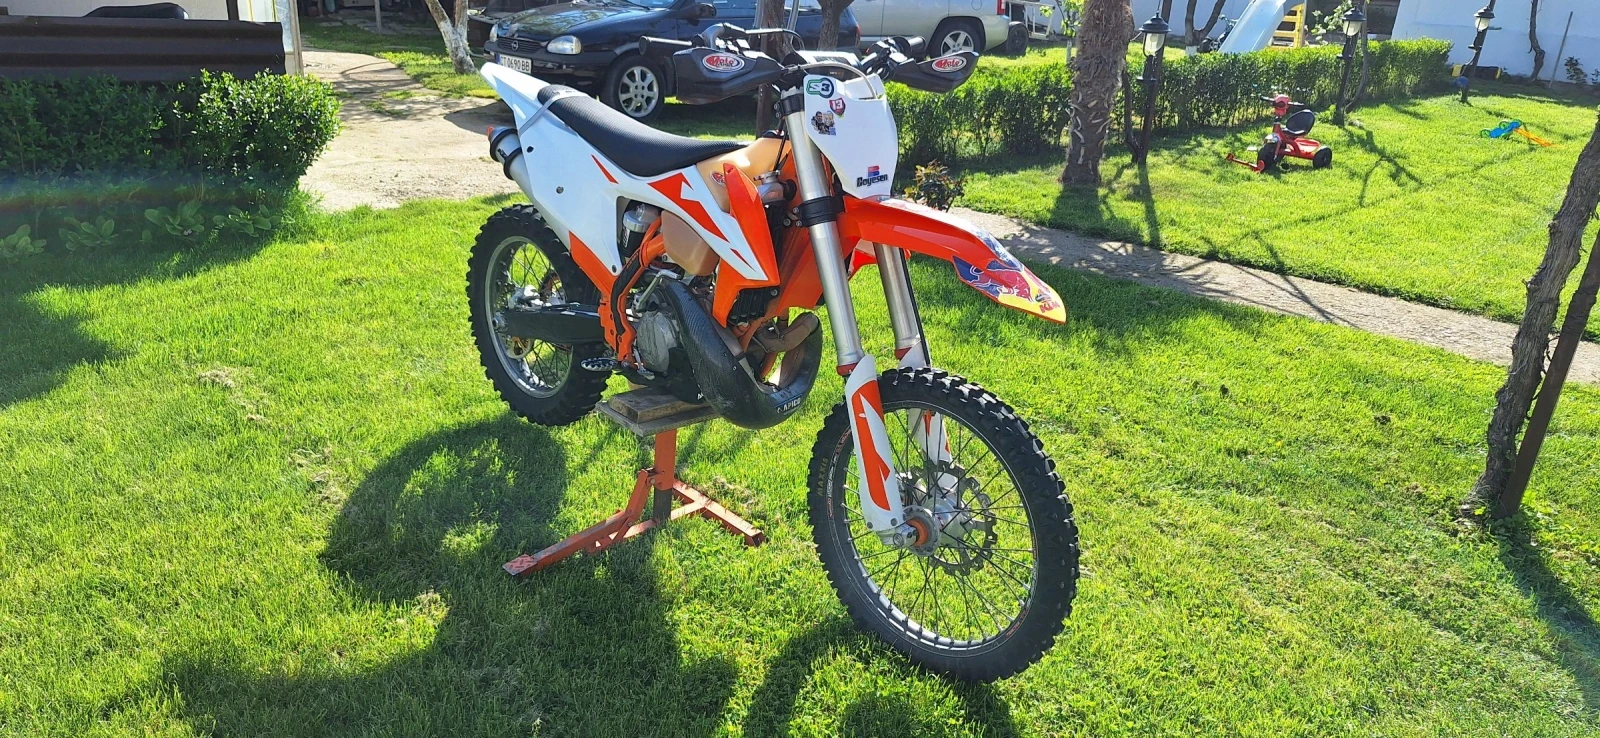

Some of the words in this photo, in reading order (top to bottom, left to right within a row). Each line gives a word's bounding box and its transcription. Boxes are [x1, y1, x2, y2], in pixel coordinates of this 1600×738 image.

[522, 60, 530, 71] BB
[831, 99, 843, 110] 13
[857, 174, 888, 187] Boyesen
[817, 457, 829, 497] MAXXIS
